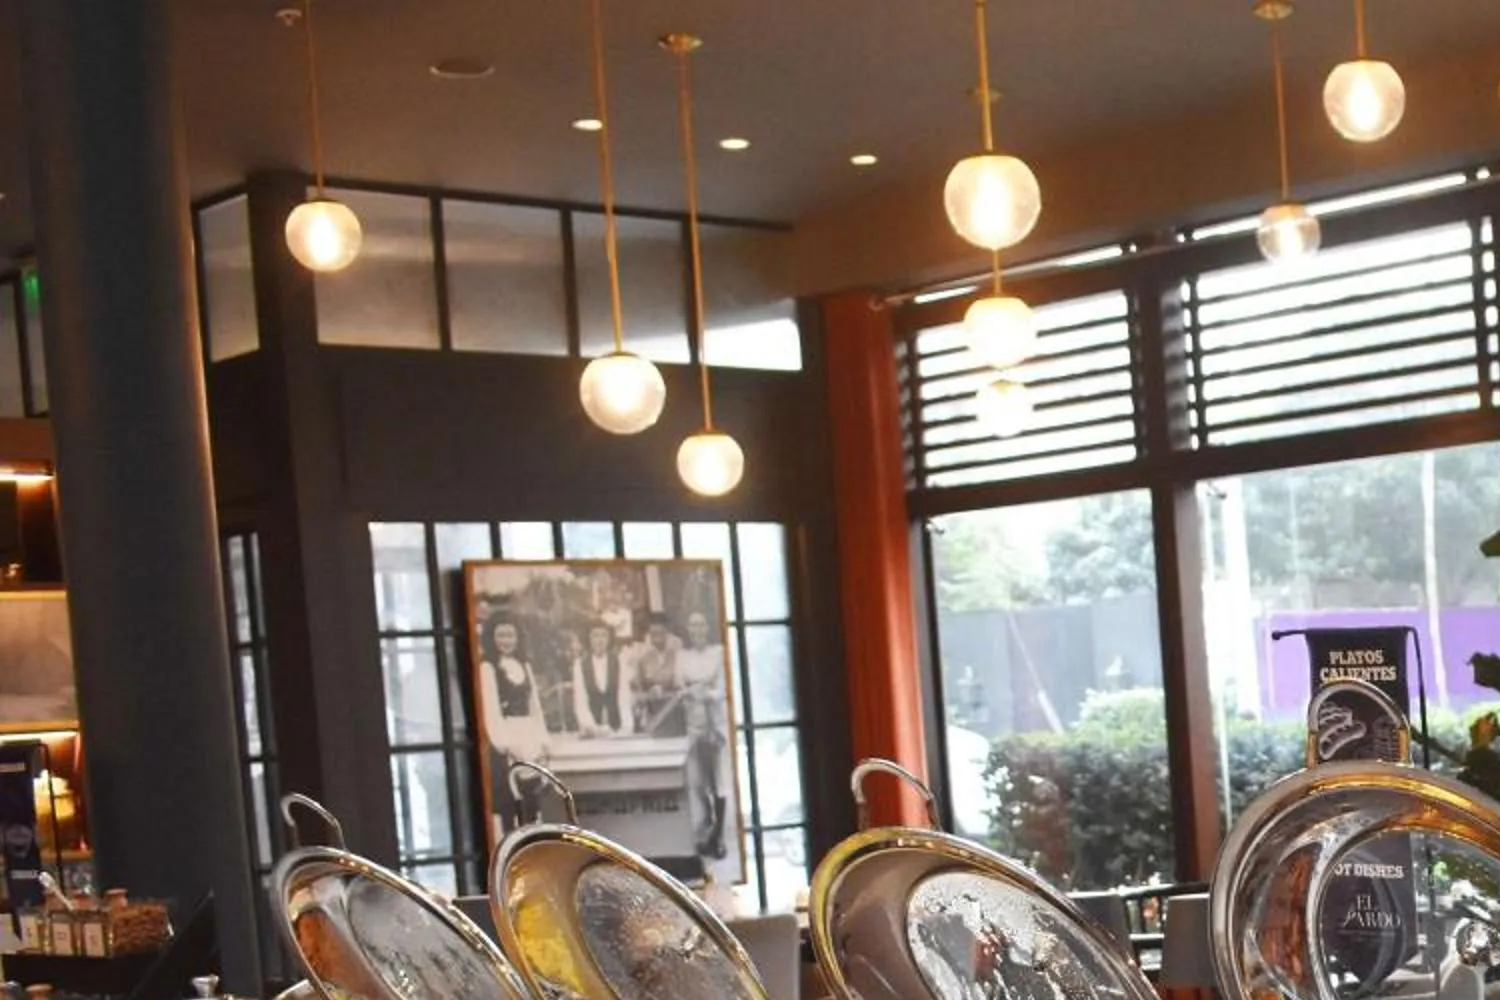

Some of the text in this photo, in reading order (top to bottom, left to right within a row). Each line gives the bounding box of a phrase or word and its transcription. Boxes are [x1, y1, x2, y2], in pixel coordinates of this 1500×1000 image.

[1328, 649, 1385, 665] PLATOS
[1319, 666, 1397, 683] CALIENTES
[1353, 863, 1405, 880] DISHES
[1356, 893, 1376, 912] EL
[1341, 911, 1402, 930] PARDO
